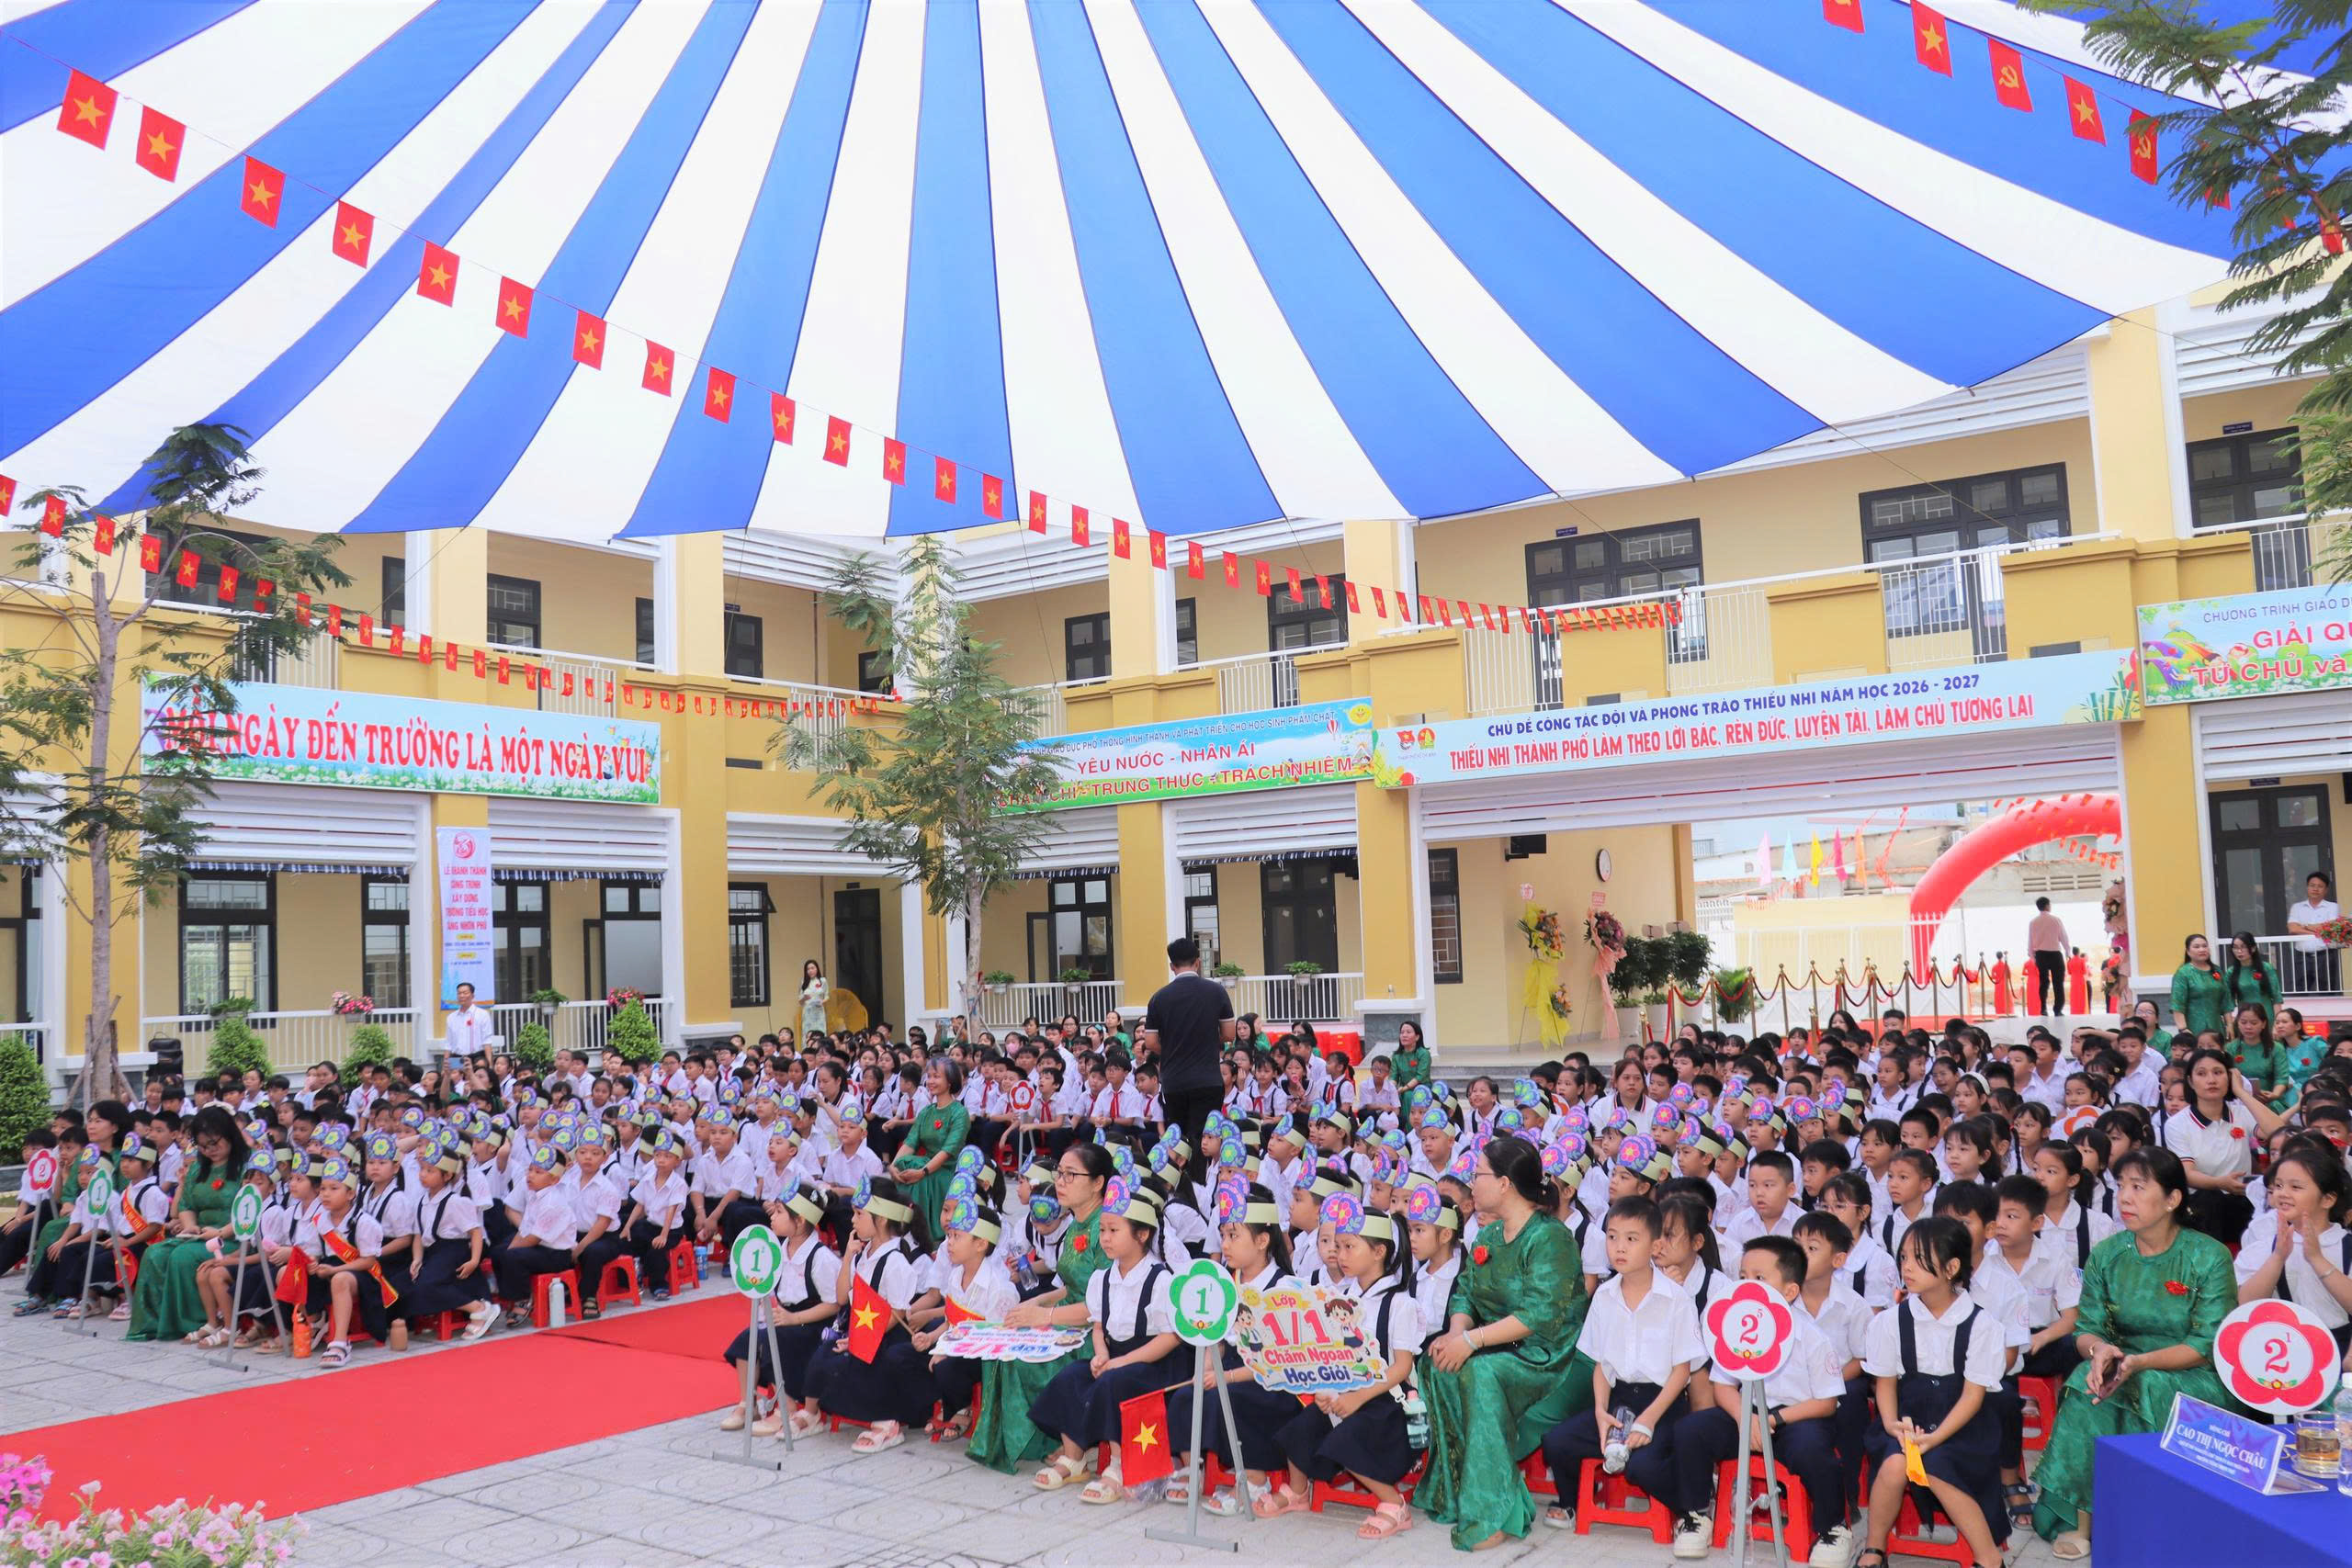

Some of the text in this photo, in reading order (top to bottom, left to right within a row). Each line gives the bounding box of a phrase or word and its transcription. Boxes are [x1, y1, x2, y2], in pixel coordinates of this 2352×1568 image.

[2253, 620, 2313, 649] GIẢI
[2192, 652, 2347, 687] TỰ CHỦ và
[1487, 720, 1512, 737] CHỦ
[1536, 716, 1571, 732] CÔNG
[1575, 713, 1598, 728] TÁC
[1602, 710, 1625, 727] ĐỘI
[1630, 706, 1647, 722] VÀ
[1651, 704, 1698, 721] PHONG
[1702, 698, 1739, 715] TRÀO
[1744, 691, 1786, 710] THIẾU
[1791, 691, 1815, 705] NHI
[1820, 684, 1854, 703] NĂM
[1859, 683, 1888, 701] HỌC
[1893, 680, 1929, 695] 2026
[1943, 674, 1979, 691] 2027
[1267, 717, 1285, 728] SINH
[1450, 694, 2033, 770] THIẾU NHI THÀNH PHỐ LÀM THEO LỜI BÁC, RÈN ĐỨC, LUYỆN TÀI, LÀM CHỦ TƯƠNG LAI
[225, 703, 300, 759] NGÀY
[307, 701, 357, 761] ĐẾN
[364, 716, 458, 769] TRƯỜNG
[466, 723, 493, 772] LÀ
[501, 726, 544, 784] MỘT
[549, 732, 606, 780] NGÀY
[611, 746, 646, 784] VUI
[1077, 758, 1110, 775] YÊU
[1116, 750, 1164, 770] NƯỚC
[1182, 739, 1231, 762] NHÂN
[1238, 739, 1255, 757] ÁI
[1091, 779, 1149, 797] TRUNG
[1156, 772, 1204, 791] THỰC
[1220, 762, 1283, 784] TRÁCH
[1290, 755, 1352, 777] NHIỆM
[39, 1164, 45, 1177] 2
[96, 1185, 102, 1201] 1
[243, 1203, 250, 1220] 1
[751, 1249, 761, 1271] 1
[1195, 1288, 1209, 1314] 1
[1272, 1293, 1296, 1308] Lớp
[1261, 1309, 1331, 1346] 1/1
[1739, 1314, 1758, 1345] 2
[1263, 1347, 1354, 1366] Chăm Ngoan
[2265, 1338, 2289, 1373] 2
[1283, 1365, 1351, 1386] Học Giỏi
[2176, 1424, 2196, 1439] CAO
[2197, 1430, 2211, 1450] THỊ
[2211, 1438, 2239, 1458] NGỌC
[2239, 1449, 2267, 1470] CHÂU
